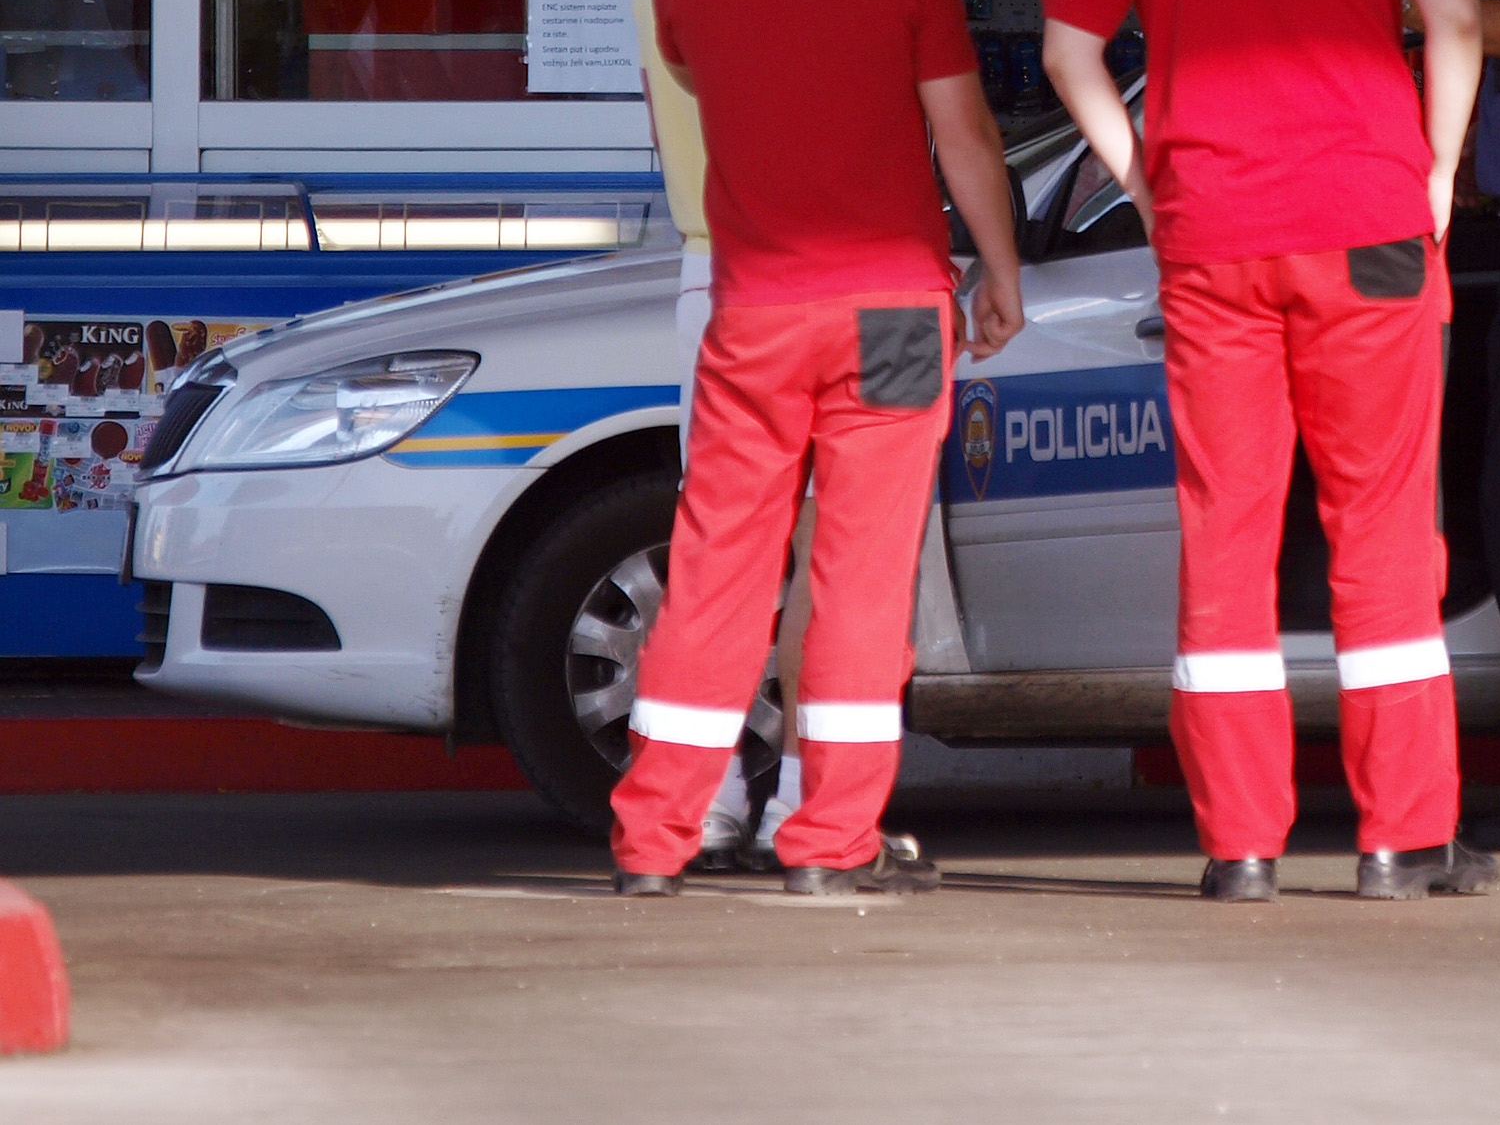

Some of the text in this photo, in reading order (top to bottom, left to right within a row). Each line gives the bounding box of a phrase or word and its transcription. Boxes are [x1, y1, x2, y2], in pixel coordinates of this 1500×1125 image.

[587, 3, 617, 13] naplate
[542, 45, 568, 53] Sretan
[569, 45, 583, 55] put
[5, 423, 36, 433] NOVO!
[1004, 400, 1166, 463] POLICIJA
